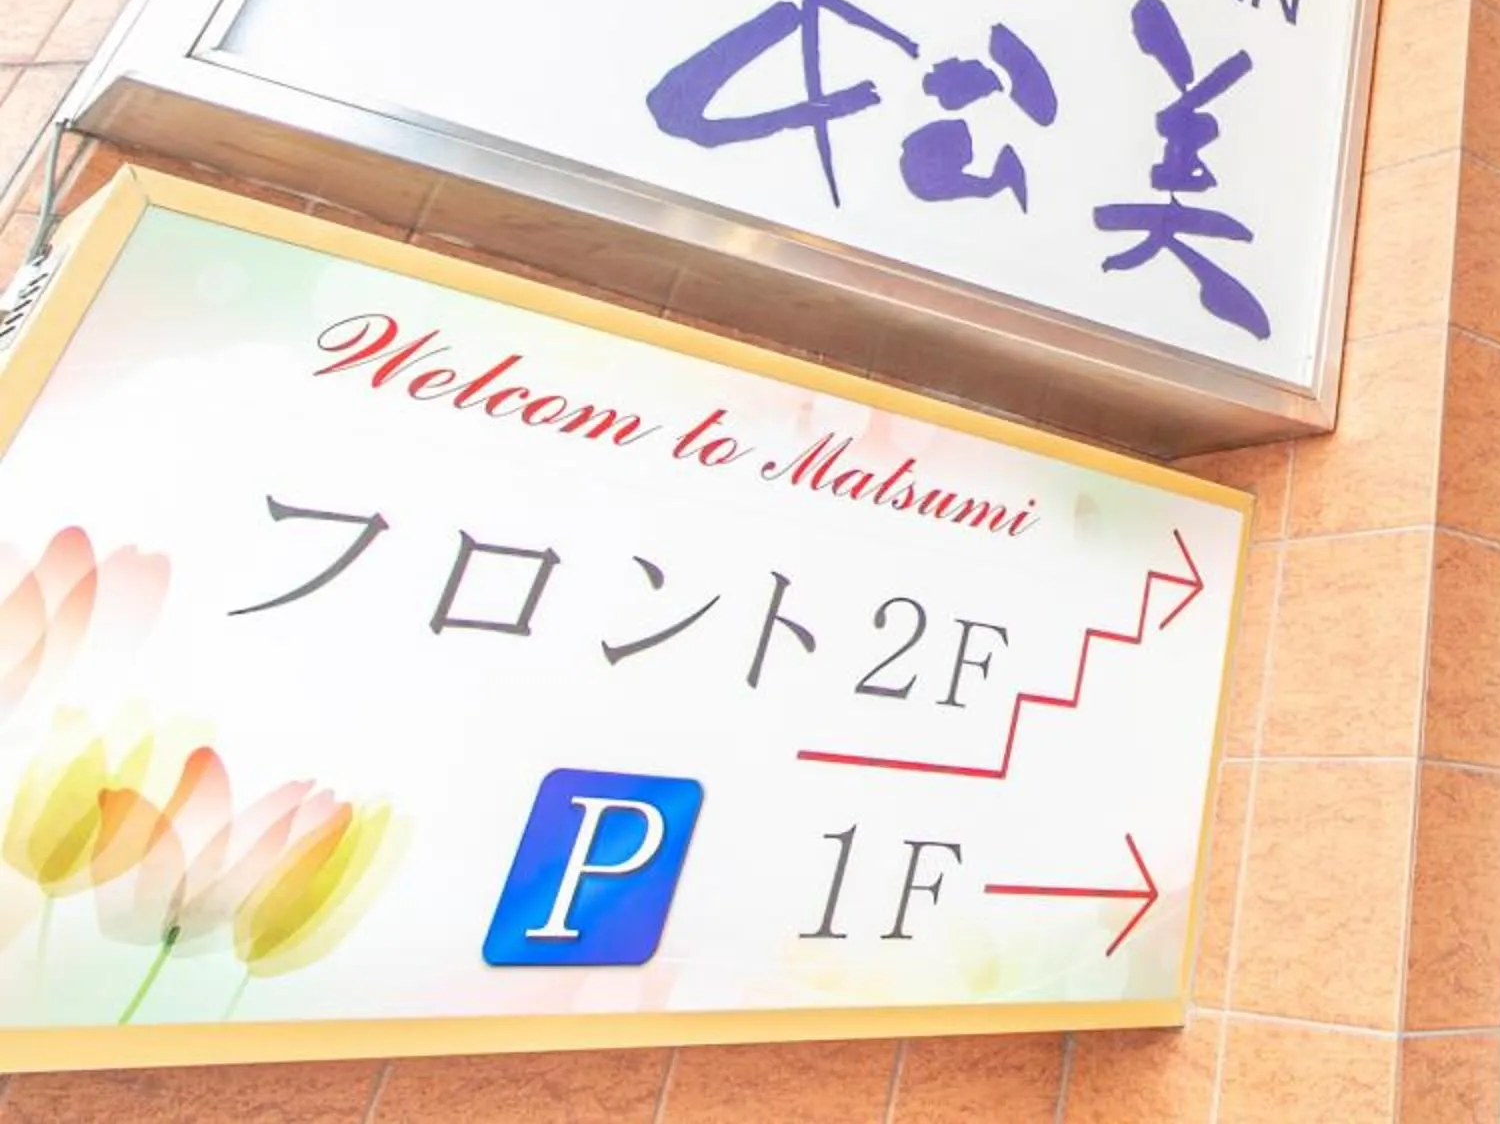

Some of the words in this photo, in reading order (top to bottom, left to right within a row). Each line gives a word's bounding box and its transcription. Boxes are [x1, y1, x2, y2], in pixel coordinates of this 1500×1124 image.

[312, 312, 662, 447] Welcom
[671, 407, 756, 468] to
[760, 430, 1042, 538] Matsumi
[525, 796, 665, 940] P
[798, 823, 964, 941] 1F
